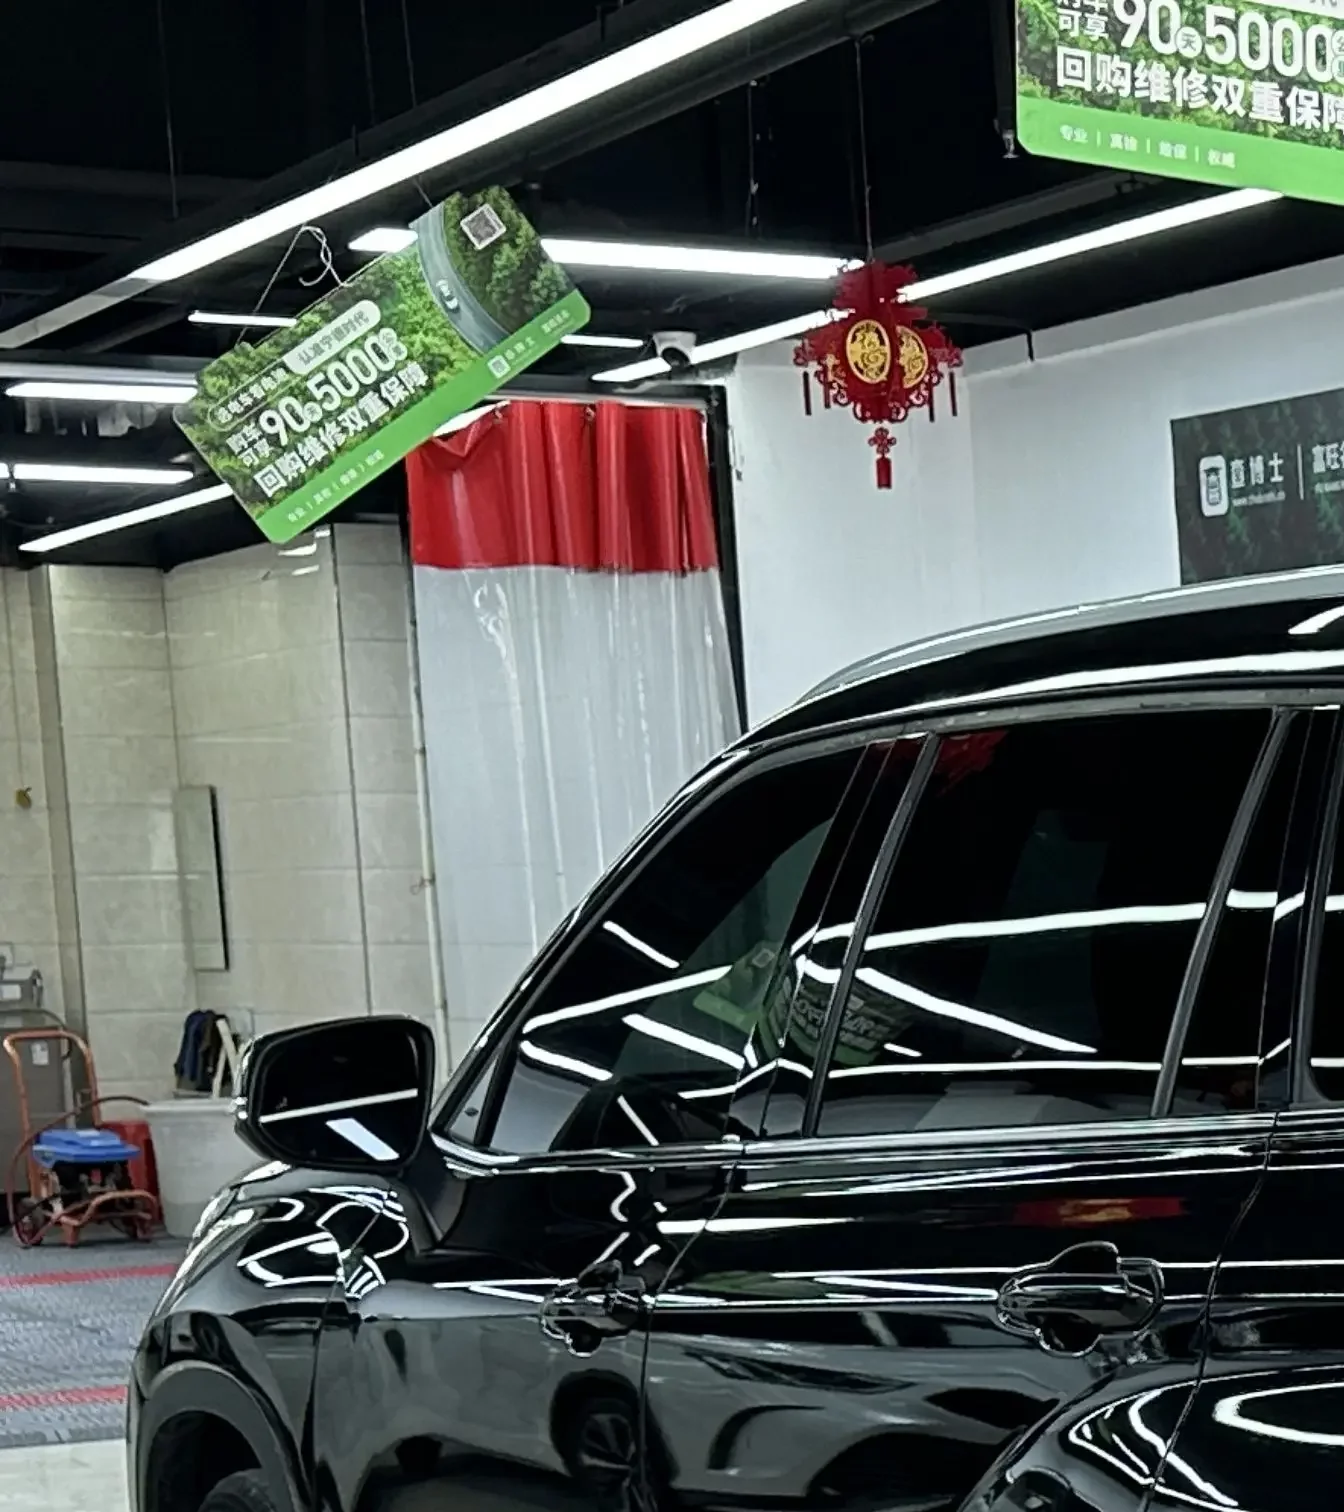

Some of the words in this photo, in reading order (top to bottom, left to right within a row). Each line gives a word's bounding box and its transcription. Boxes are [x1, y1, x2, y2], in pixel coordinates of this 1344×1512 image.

[253, 361, 429, 498] 回购维修双重保障
